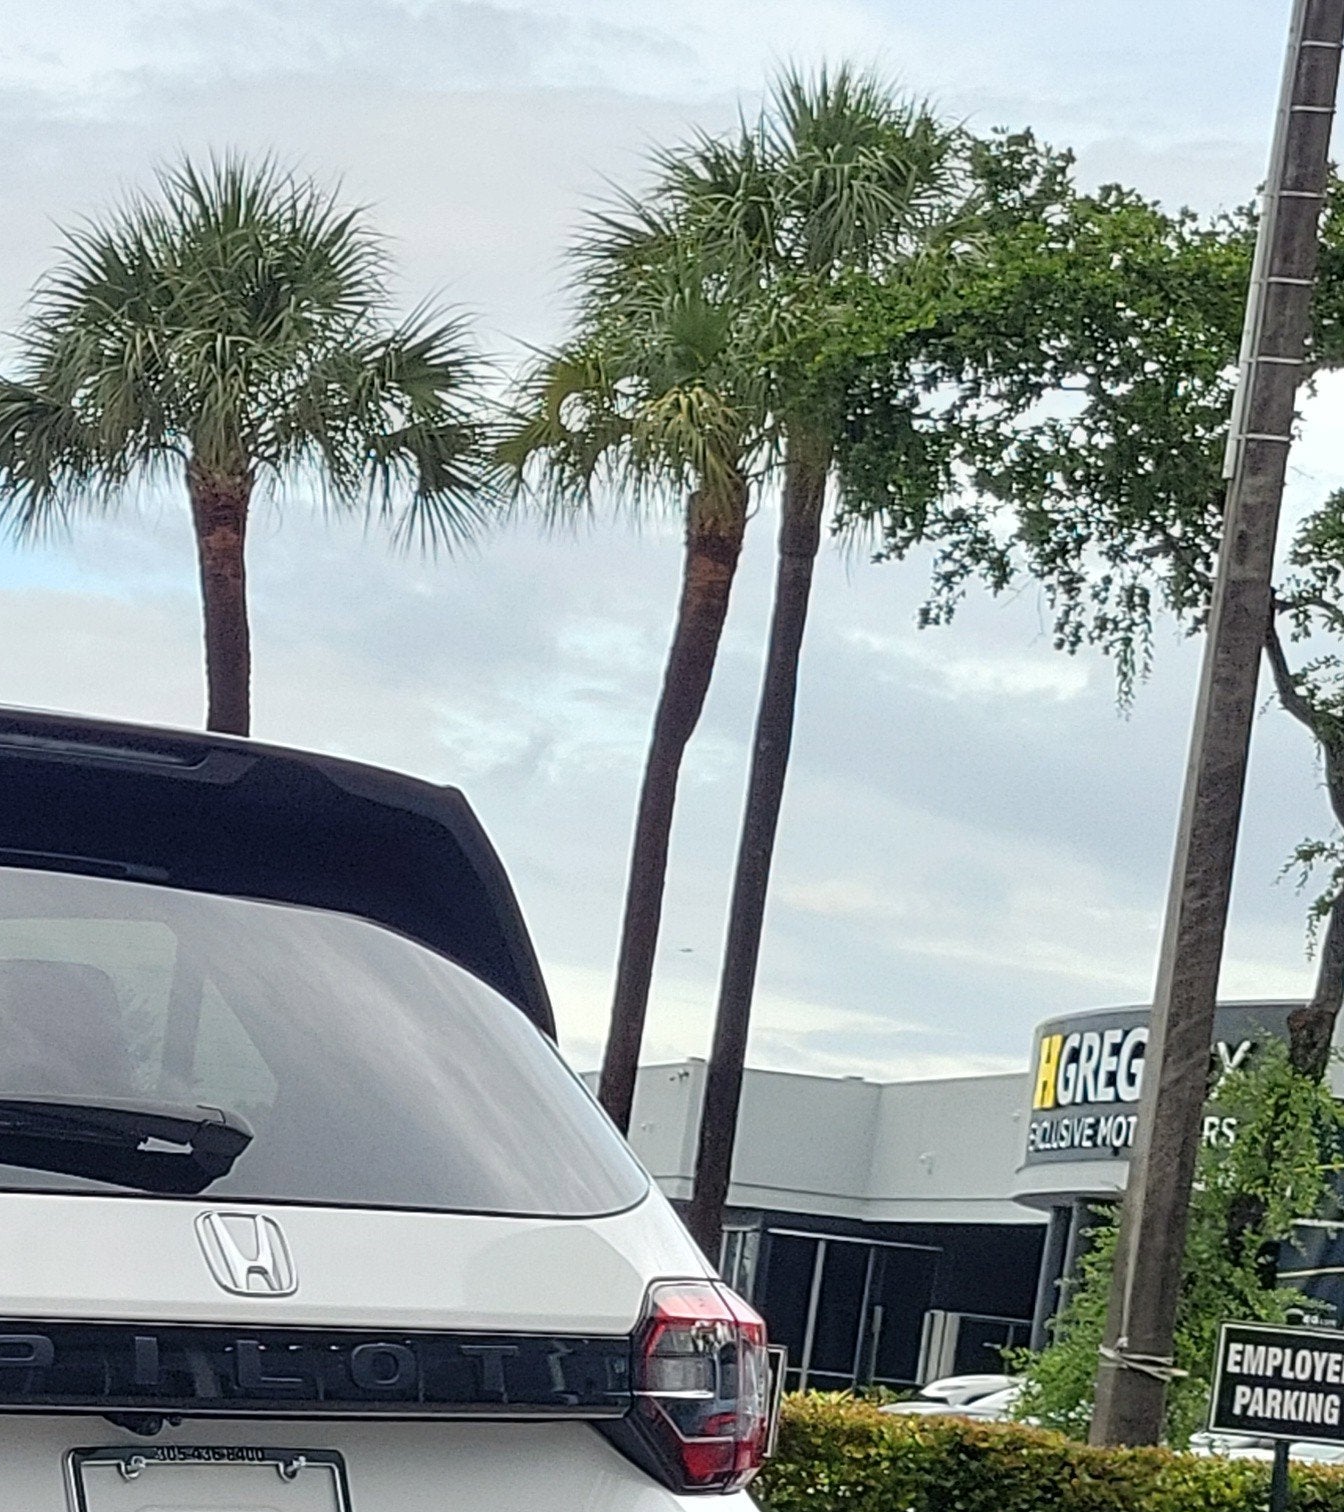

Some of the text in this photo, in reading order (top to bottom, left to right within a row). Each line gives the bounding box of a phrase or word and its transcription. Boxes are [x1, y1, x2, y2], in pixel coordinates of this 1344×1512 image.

[1033, 1027, 1251, 1110] HGREGY
[1226, 1342, 1344, 1384] EMPLOYE
[1232, 1384, 1340, 1425] PARKING
